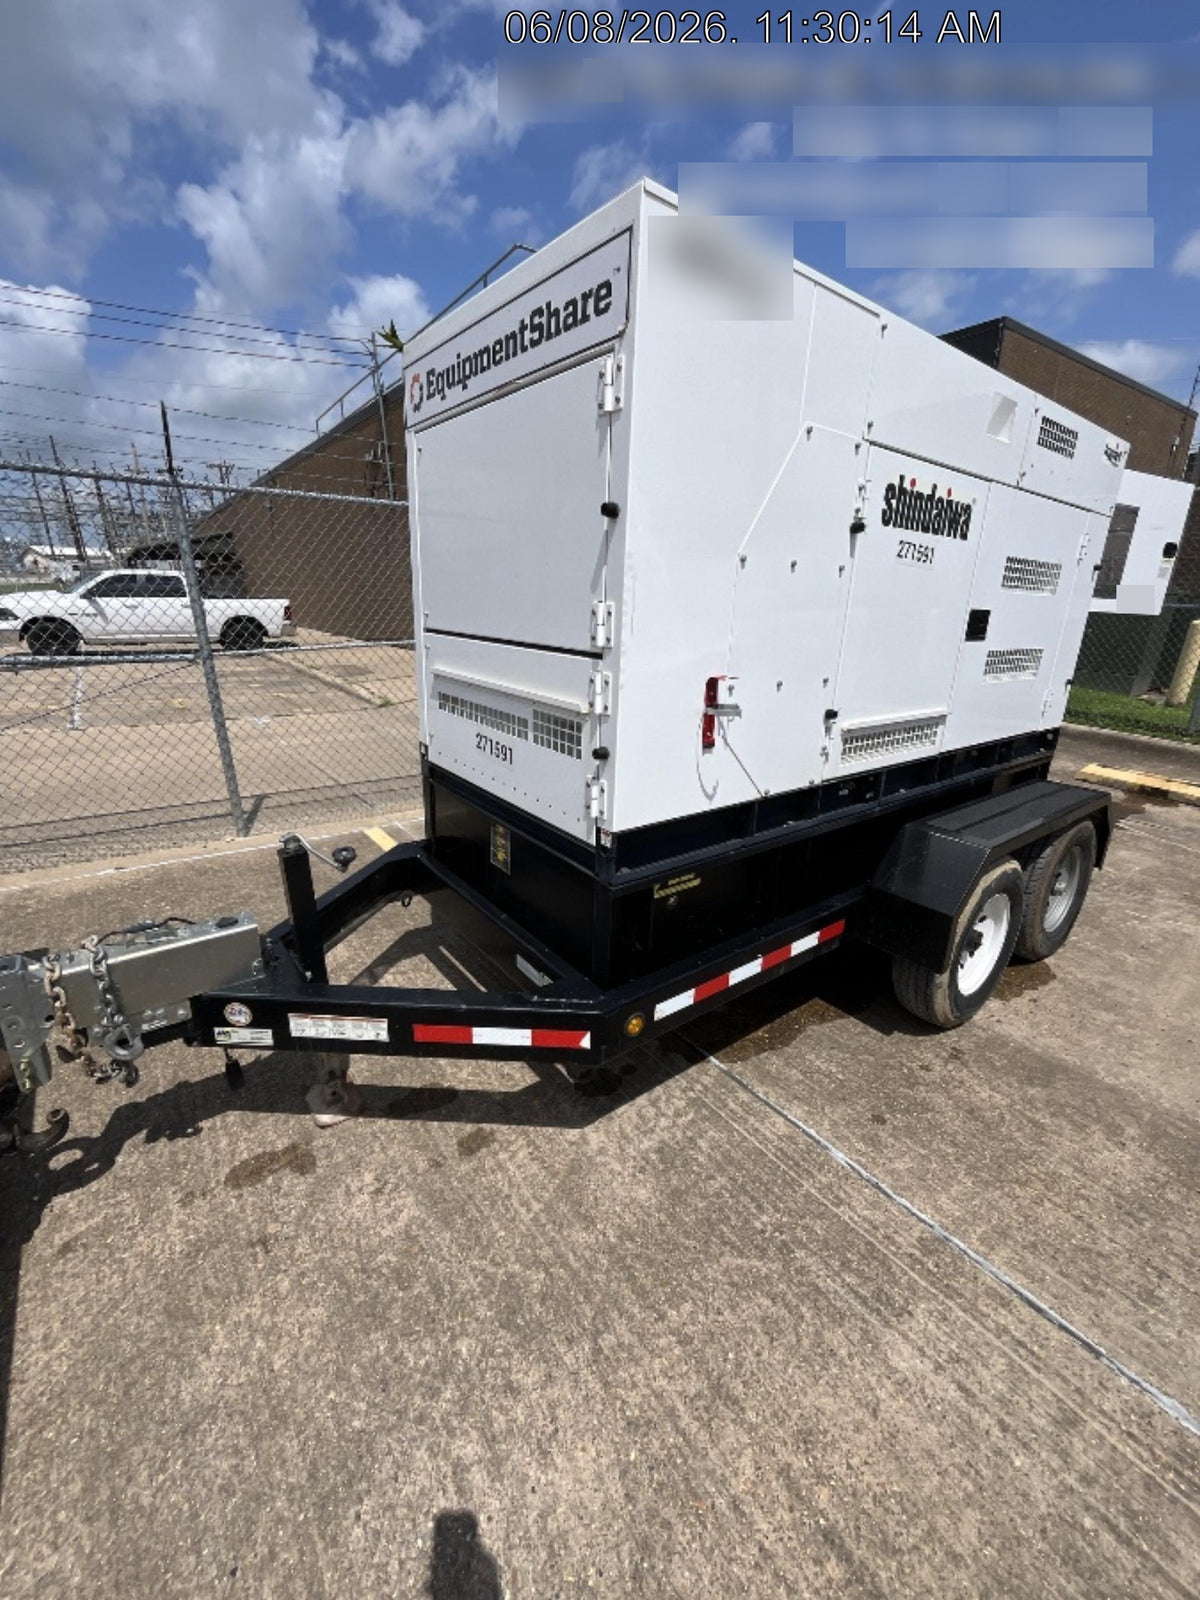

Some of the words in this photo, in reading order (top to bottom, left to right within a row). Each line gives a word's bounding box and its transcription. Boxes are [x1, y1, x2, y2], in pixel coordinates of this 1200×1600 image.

[425, 279, 613, 402] EquipmentShare
[881, 474, 972, 541] shindaiwa
[475, 732, 513, 765] 271591
